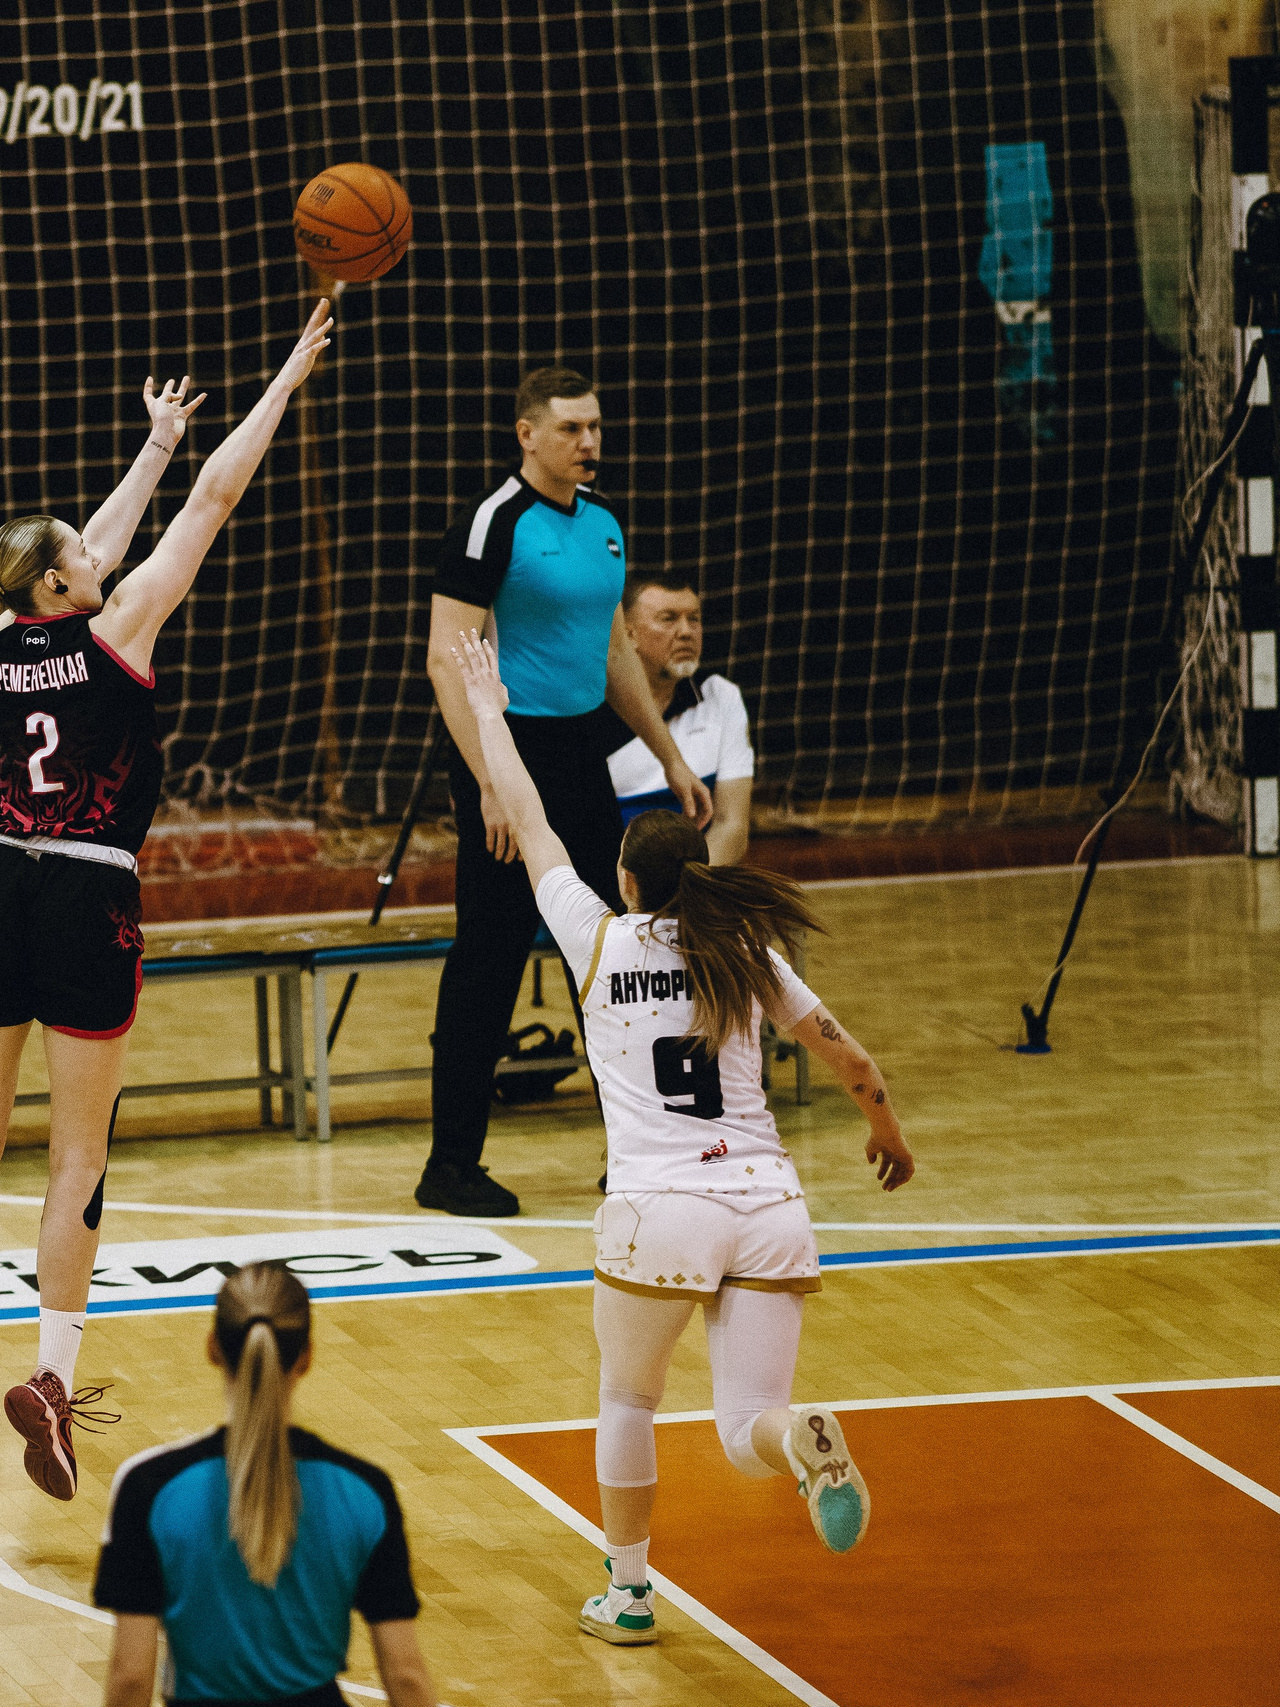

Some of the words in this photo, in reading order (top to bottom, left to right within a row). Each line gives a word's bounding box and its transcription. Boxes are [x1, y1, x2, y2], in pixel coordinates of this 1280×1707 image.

[26, 636, 46, 645] РФБ
[25, 711, 64, 794] 2
[652, 1036, 725, 1120] 9
